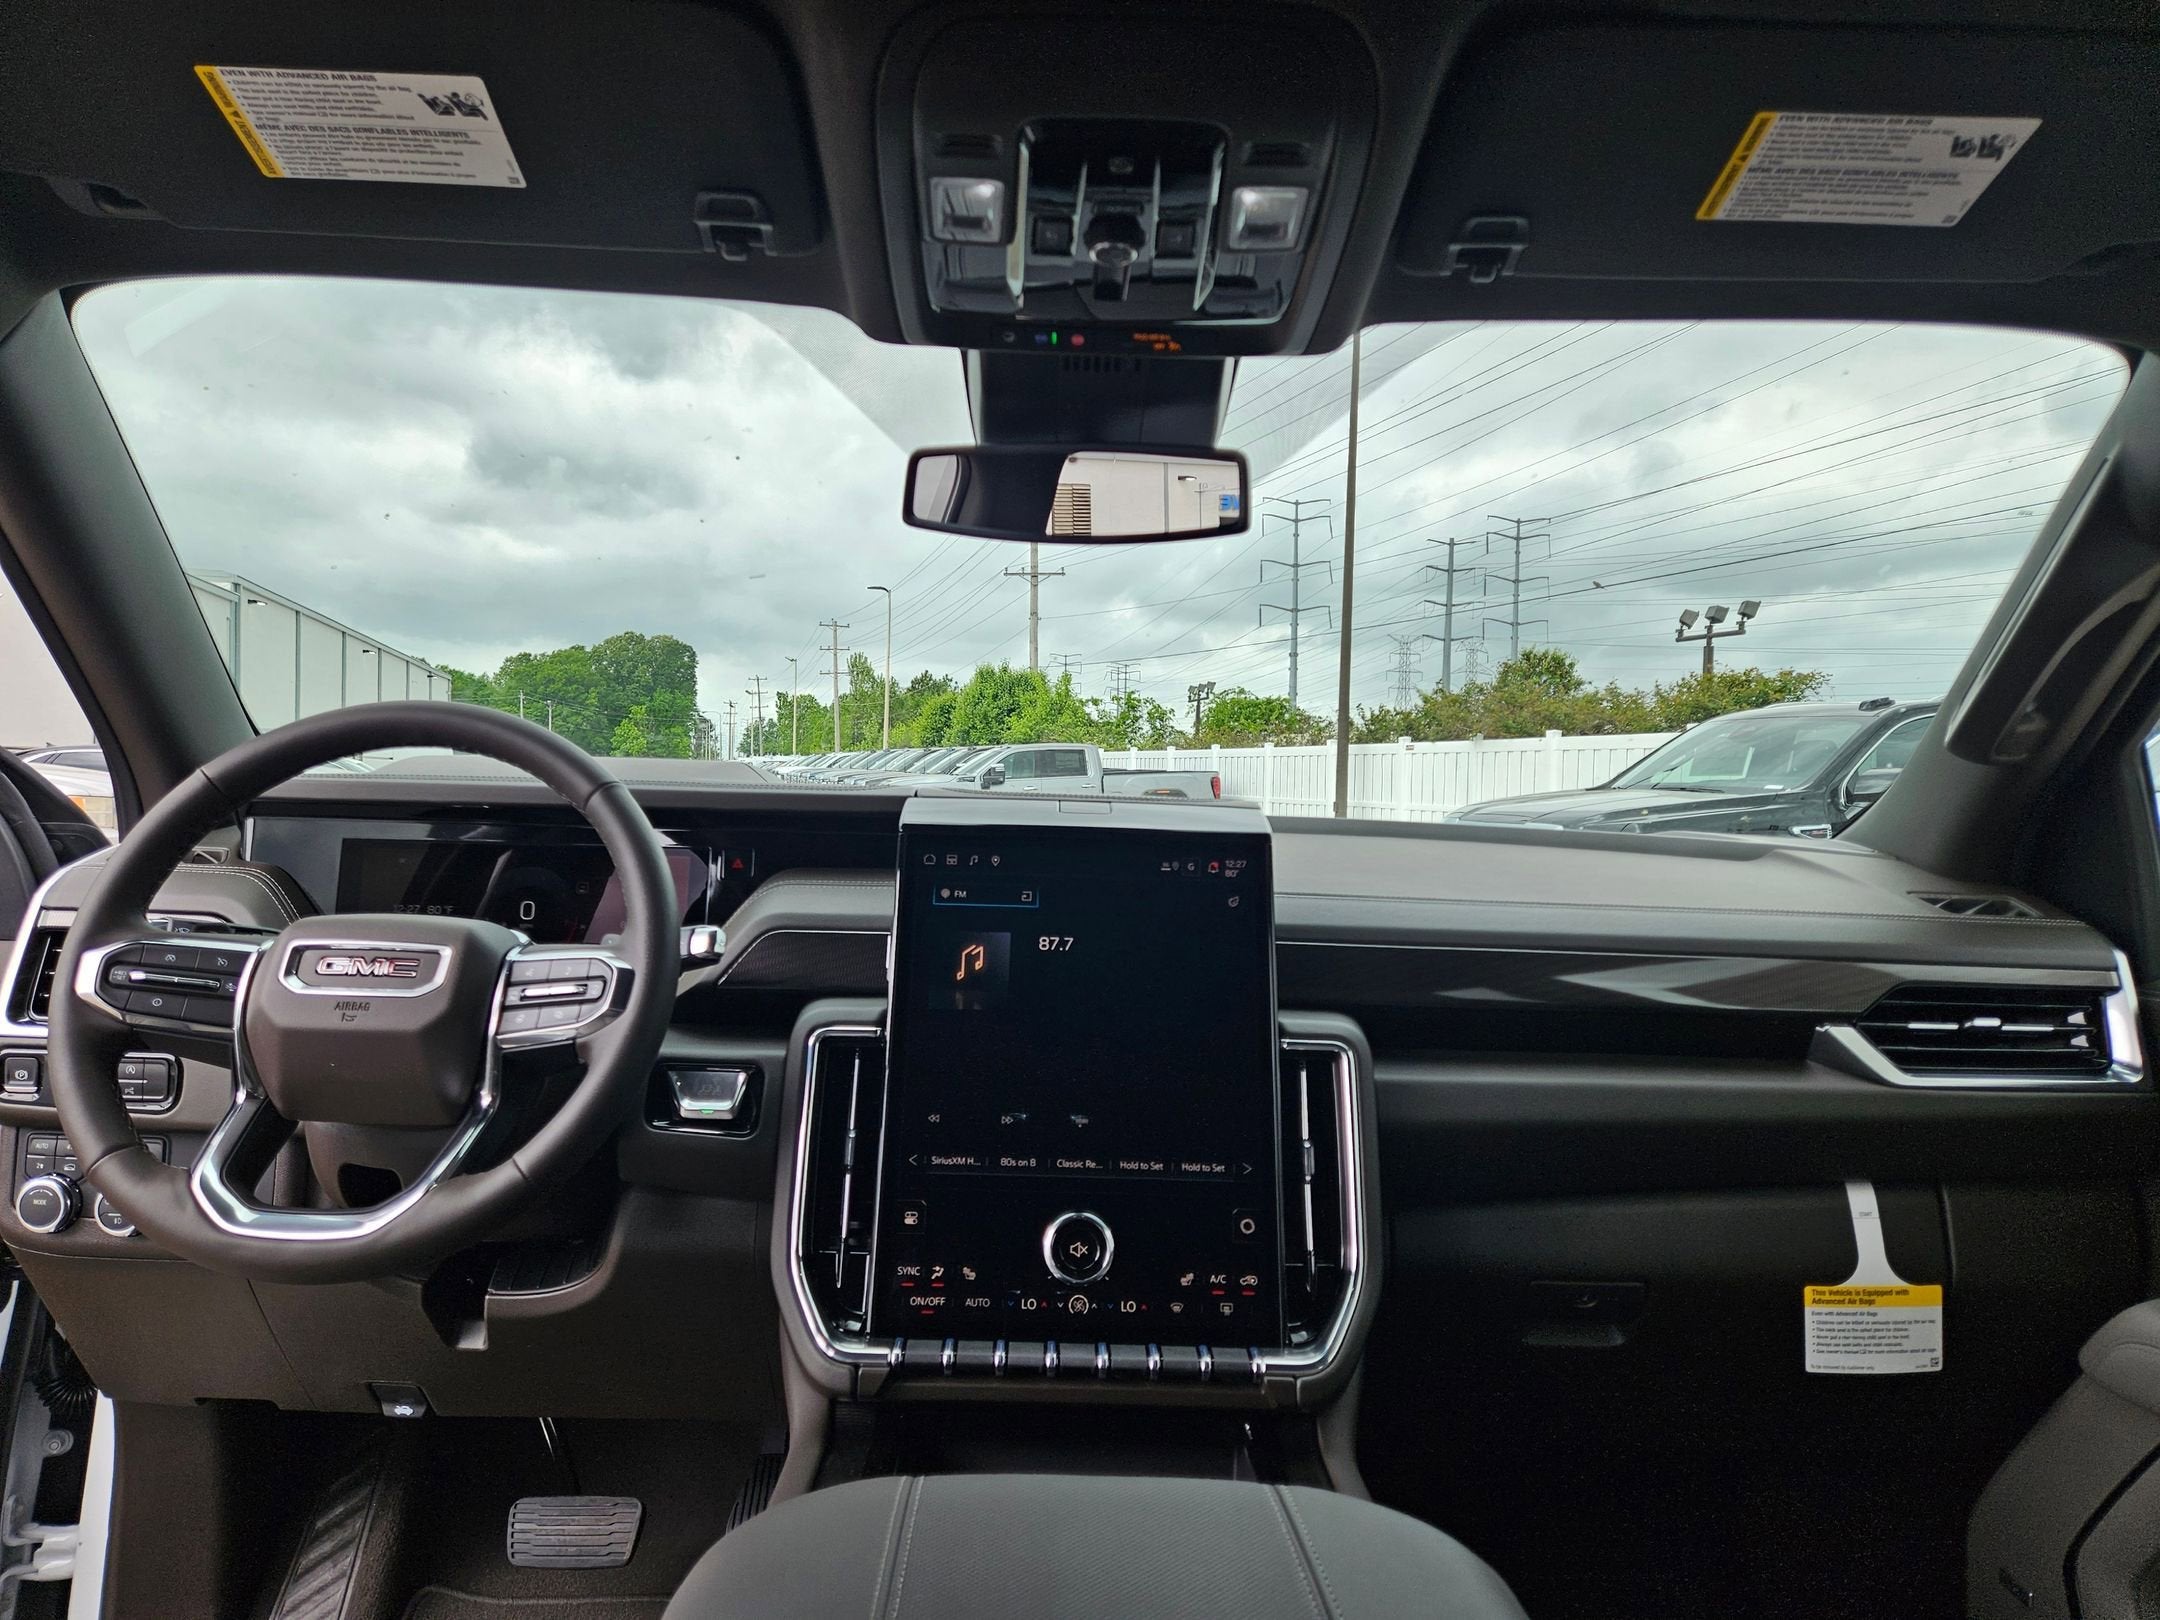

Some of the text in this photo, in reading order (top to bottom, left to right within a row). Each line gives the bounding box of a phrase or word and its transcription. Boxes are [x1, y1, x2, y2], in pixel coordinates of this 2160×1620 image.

[246, 70, 274, 78] WITH
[954, 890, 967, 898] FM
[519, 900, 536, 920] 0
[1038, 936, 1074, 951] 87.7
[316, 956, 420, 978] GMC
[334, 1002, 370, 1011] AIRBAG
[931, 1156, 966, 1165] SiriusXM
[1000, 1158, 1016, 1166] 80s
[1030, 1158, 1036, 1167] 8
[1056, 1159, 1084, 1168] Classic
[1120, 1161, 1139, 1170] Hold
[1150, 1162, 1164, 1170] Set
[1182, 1163, 1200, 1172] Hold
[1212, 1164, 1226, 1172] Set
[897, 1266, 920, 1276] SYNC
[1210, 1274, 1226, 1284] A/C
[1862, 1289, 1893, 1297] Equipped
[910, 1297, 946, 1306] ON/OFF
[965, 1298, 991, 1307] AUTO
[1021, 1299, 1037, 1310] LO
[1120, 1301, 1136, 1312] LO
